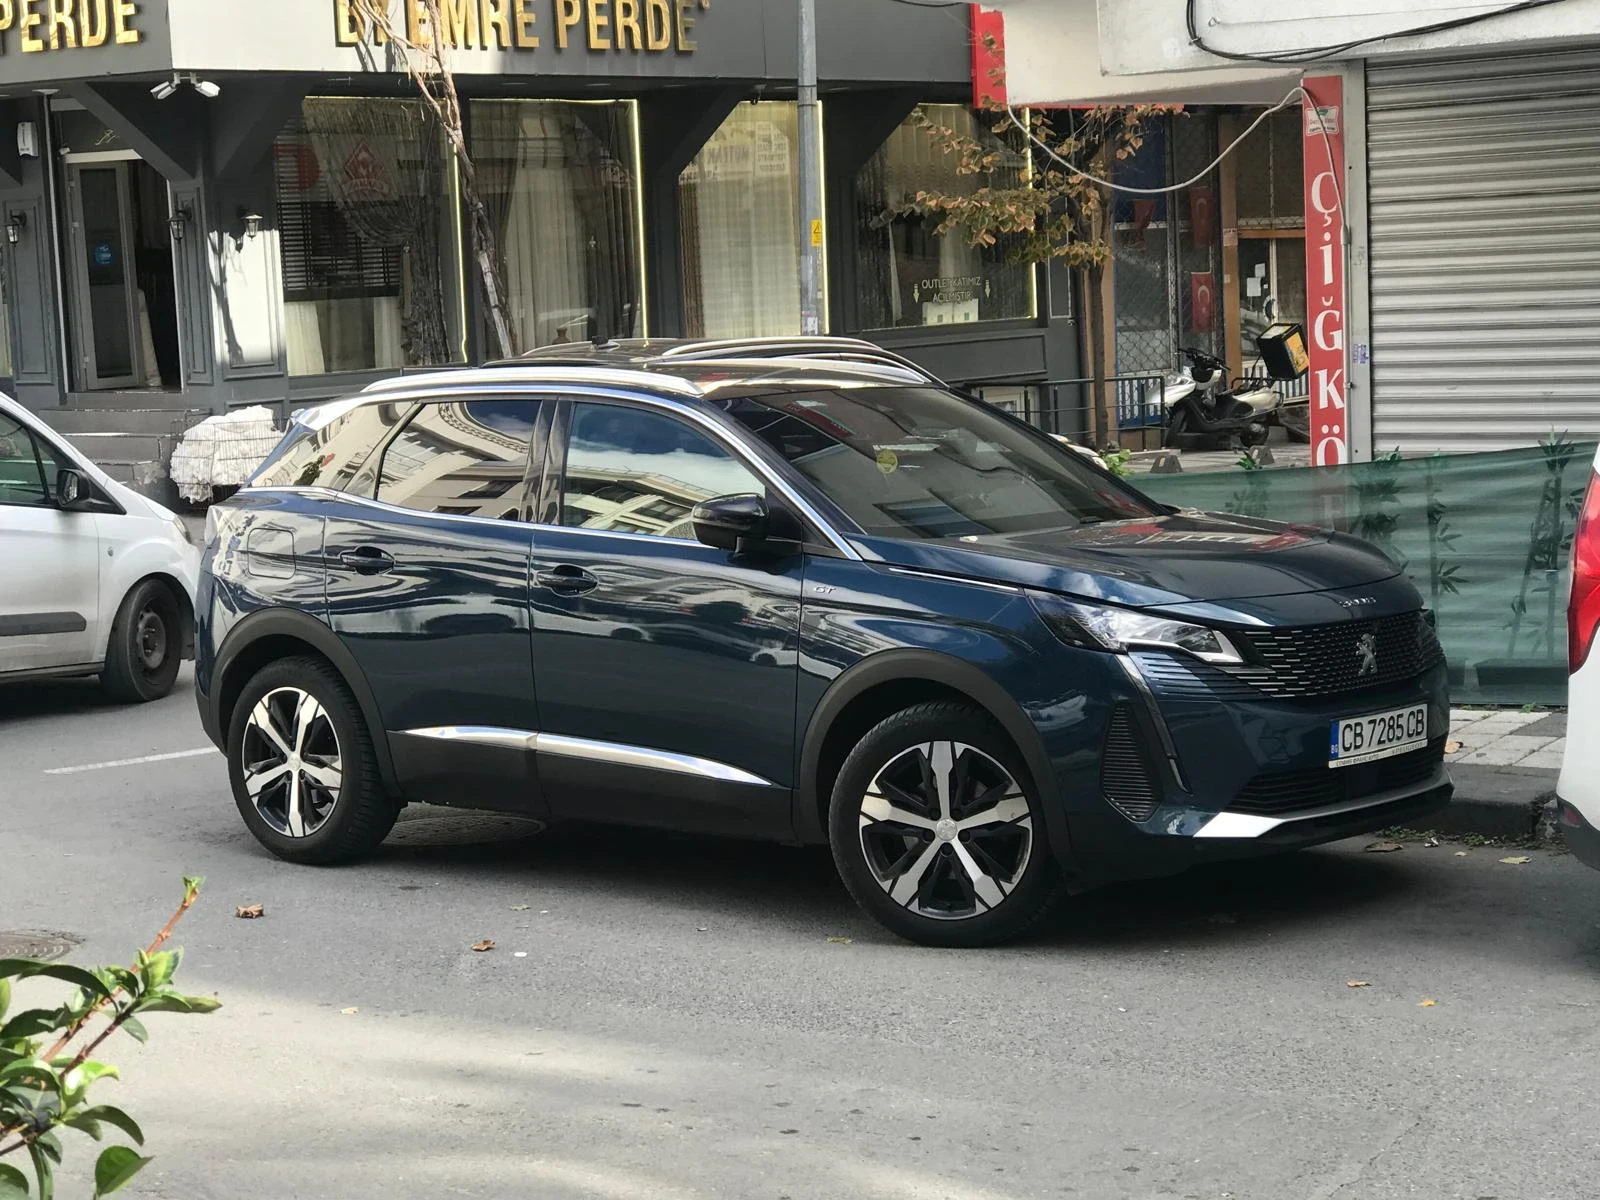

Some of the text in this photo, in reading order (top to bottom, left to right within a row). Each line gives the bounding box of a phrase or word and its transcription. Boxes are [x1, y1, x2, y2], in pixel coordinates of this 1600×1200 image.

[405, 0, 540, 49] EMRE
[555, 0, 698, 51] PERDE
[921, 278, 950, 289] OUTLET
[815, 586, 837, 594] GT
